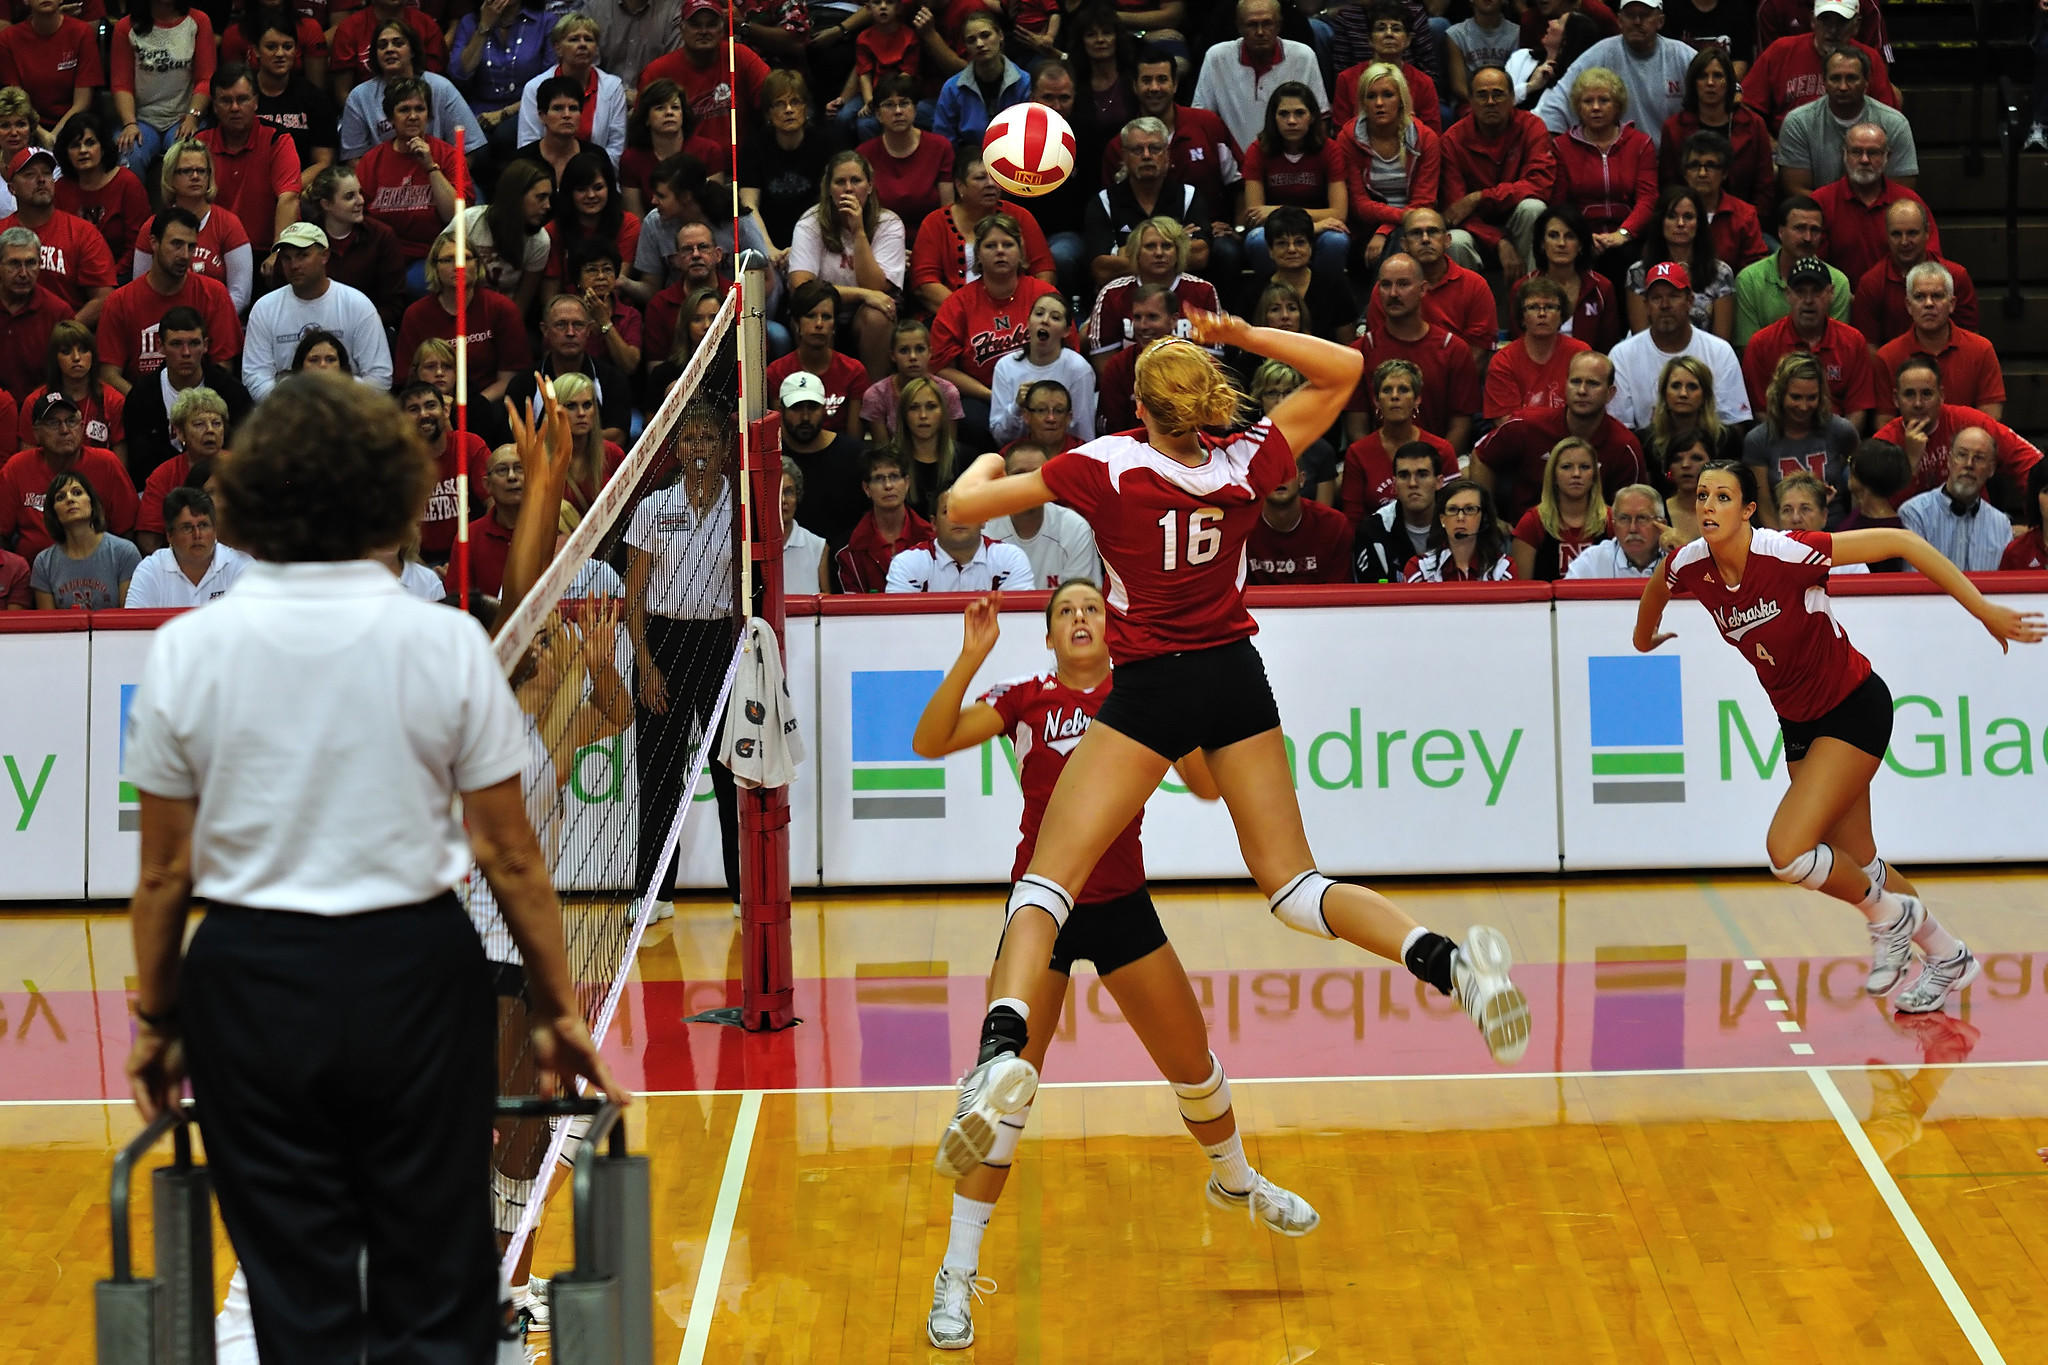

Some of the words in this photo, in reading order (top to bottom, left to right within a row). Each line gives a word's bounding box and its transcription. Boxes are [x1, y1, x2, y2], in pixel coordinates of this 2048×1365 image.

[1666, 79, 1681, 94] N
[1189, 147, 1205, 162] N
[39, 246, 67, 275] SKA
[1656, 264, 1671, 276] N
[1584, 302, 1598, 316] N
[992, 315, 1011, 332] N
[1158, 506, 1226, 572] 16
[1046, 575, 1060, 589] N
[1713, 596, 1781, 634] Nebraska
[1754, 642, 1776, 667] 4
[1043, 705, 1093, 742] Nebr
